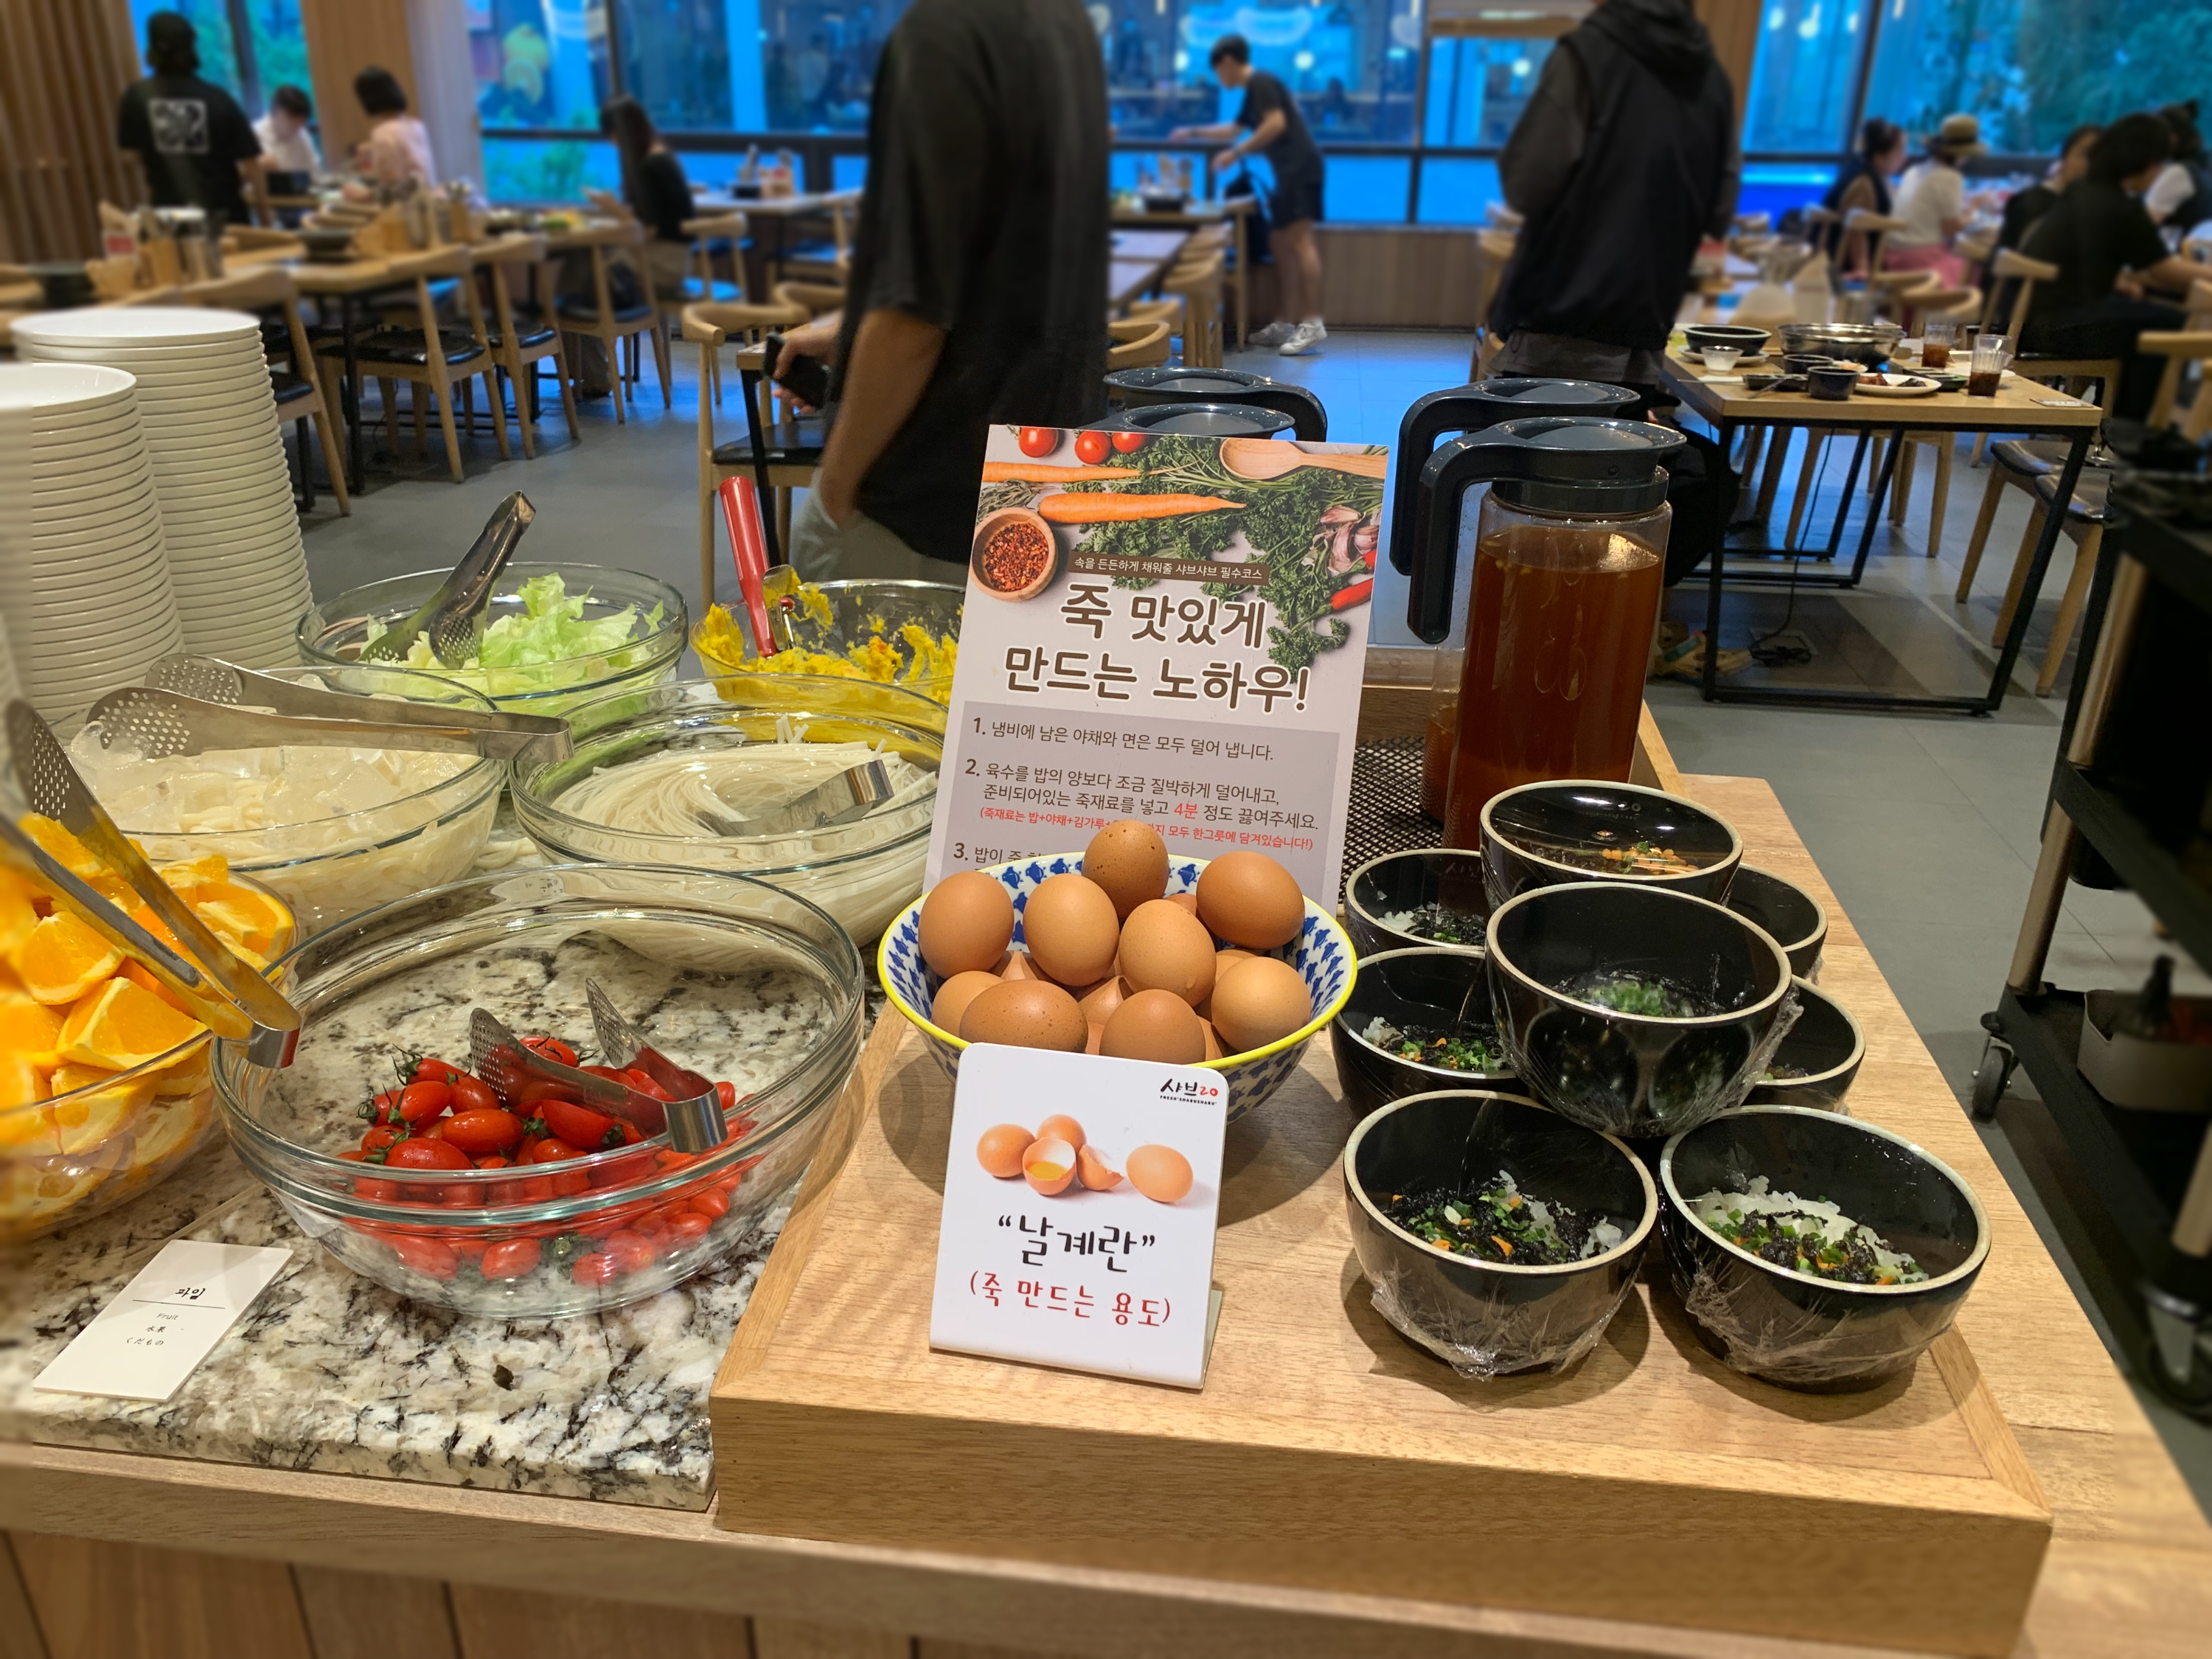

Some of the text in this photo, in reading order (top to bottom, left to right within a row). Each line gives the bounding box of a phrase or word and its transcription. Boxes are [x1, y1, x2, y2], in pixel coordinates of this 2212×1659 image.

[1074, 557, 1262, 580] 속을 든든하게 채워줄 샤브샤브 필수코스
[1060, 583, 1266, 649] 죽 맛있게
[1004, 646, 1310, 713] 만드는 노하우!
[973, 717, 1273, 761] 1. 냄비에 남은 야채와 면은 모두 덜어 냅니다.
[965, 758, 1279, 806] 2. 육수를 밥의 양보다 조금 질박하게 덜어내고,
[980, 807, 1026, 823] (죽재료는
[1029, 812, 1119, 830] 밥+야채+김가루+
[1167, 824, 1189, 838] 모두
[1193, 827, 1237, 844] 한그릇에
[1239, 832, 1314, 851] 담겨있습니다!)
[983, 784, 1318, 830] 준비되어있는 죽재료를 넣고 4분 정도 끓여주세요.
[953, 842, 969, 861] 3.
[975, 846, 1003, 864] 밥이
[156, 1312, 179, 1321] Fruit
[969, 1270, 1171, 1327] (죽 만드는 용도)
